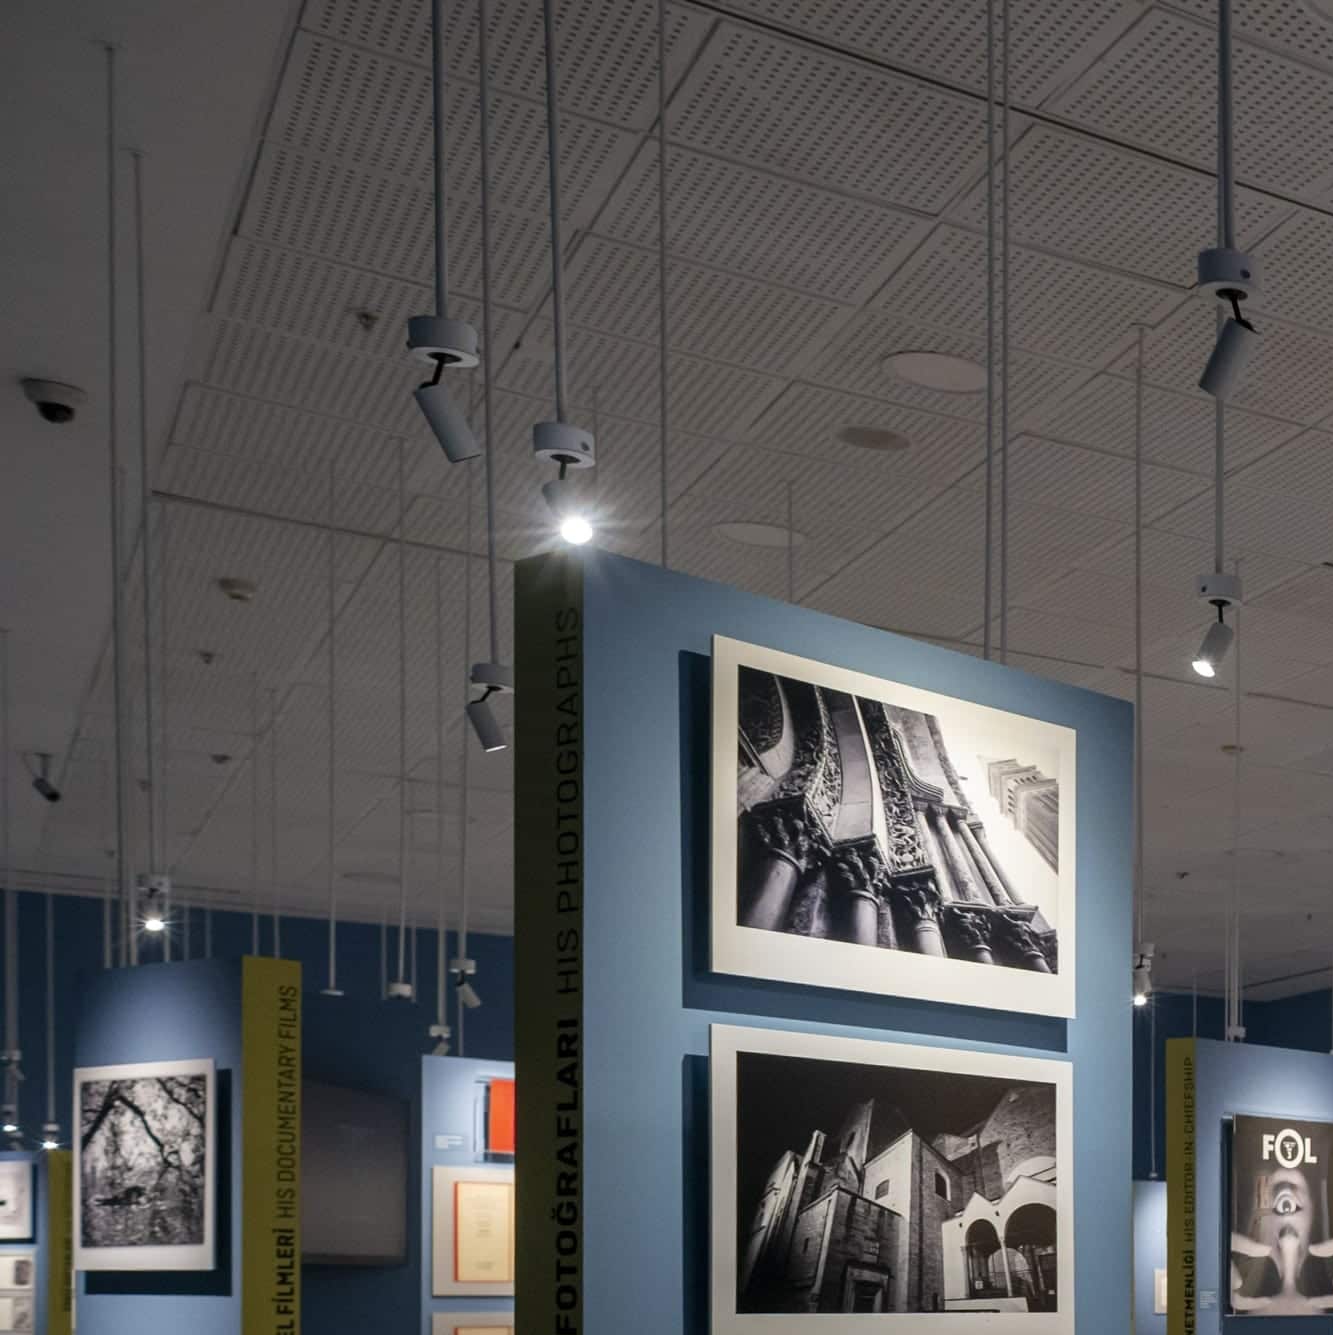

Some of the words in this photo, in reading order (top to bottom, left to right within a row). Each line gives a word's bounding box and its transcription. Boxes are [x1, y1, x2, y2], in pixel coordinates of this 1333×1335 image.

[555, 605, 580, 913] PHOTOGRAPHS
[555, 928, 580, 994] HIS
[278, 984, 298, 1040] FILMS
[277, 1044, 296, 1182] DOCUMENTARY
[1263, 1128, 1317, 1168] FOL
[277, 1188, 296, 1219] HIS
[1184, 1218, 1194, 1242] HIS
[272, 1227, 295, 1315] FİLMLERİ
